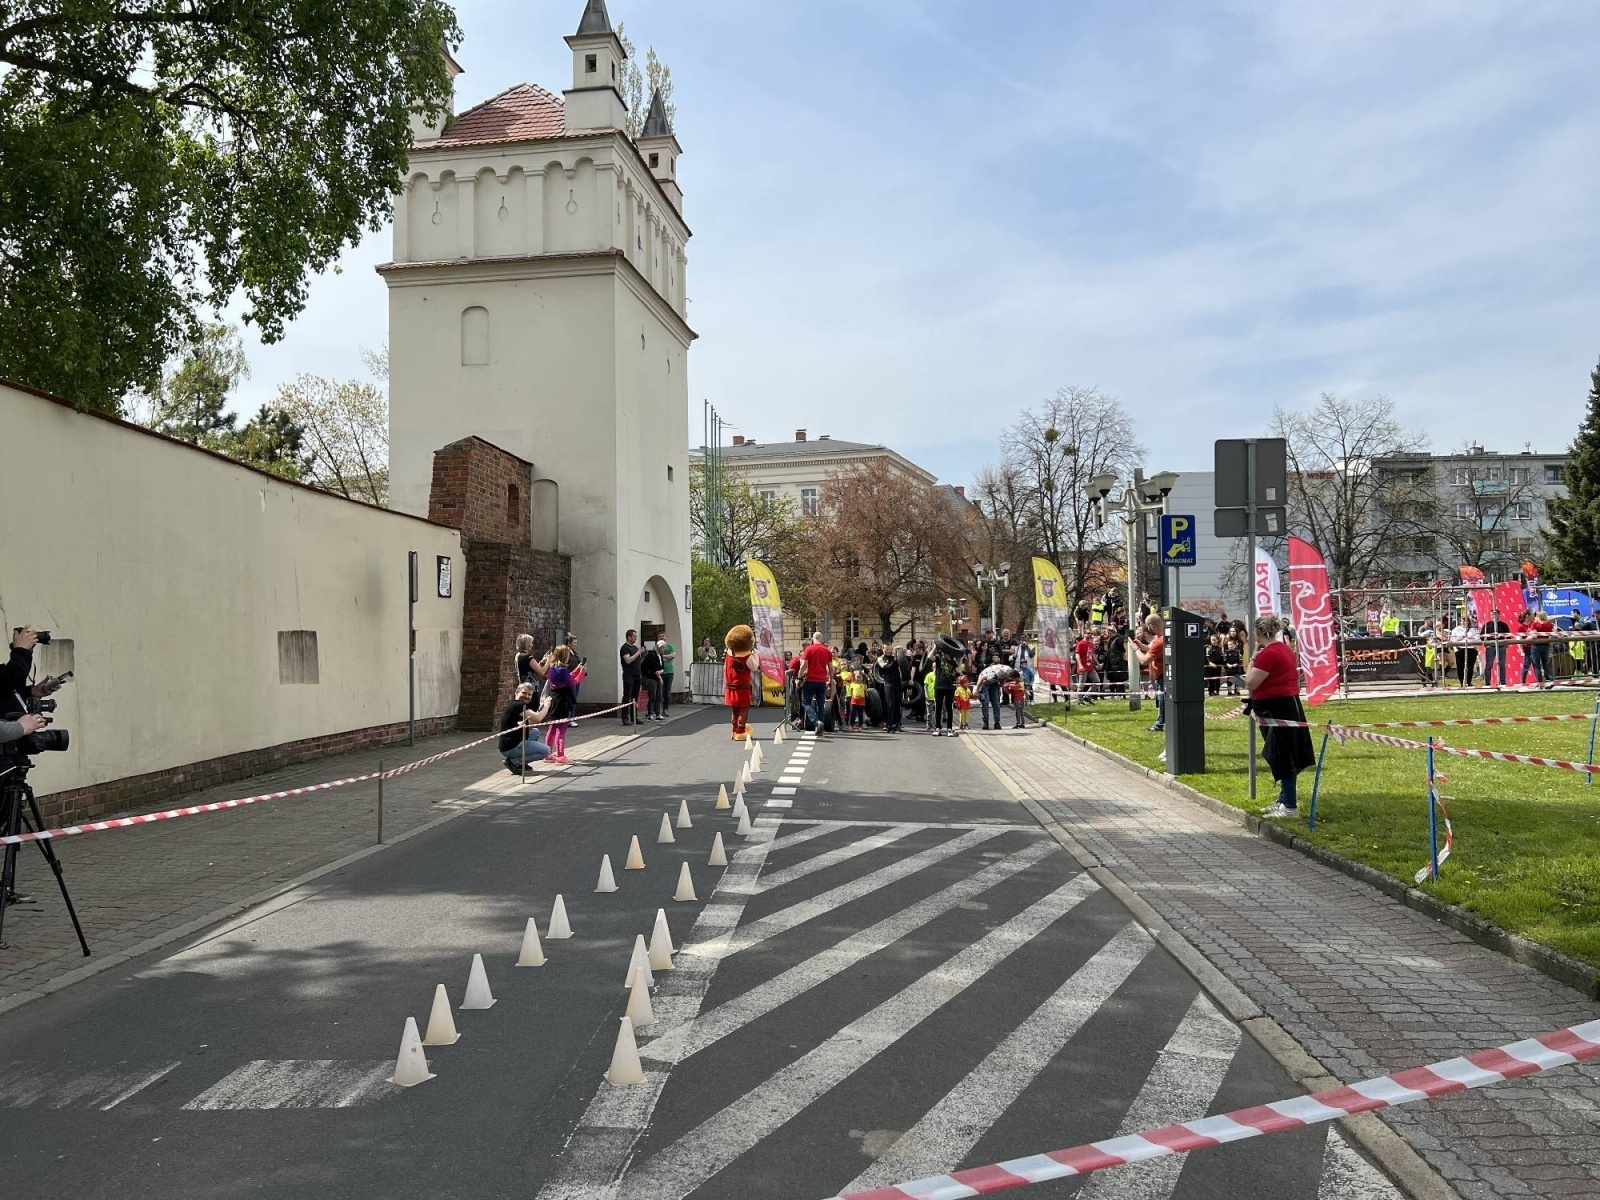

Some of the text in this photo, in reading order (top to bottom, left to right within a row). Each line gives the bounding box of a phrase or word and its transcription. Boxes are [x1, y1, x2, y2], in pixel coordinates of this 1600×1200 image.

[1171, 517, 1189, 539] P
[1187, 624, 1197, 637] P
[1345, 649, 1399, 660] EXPERT
